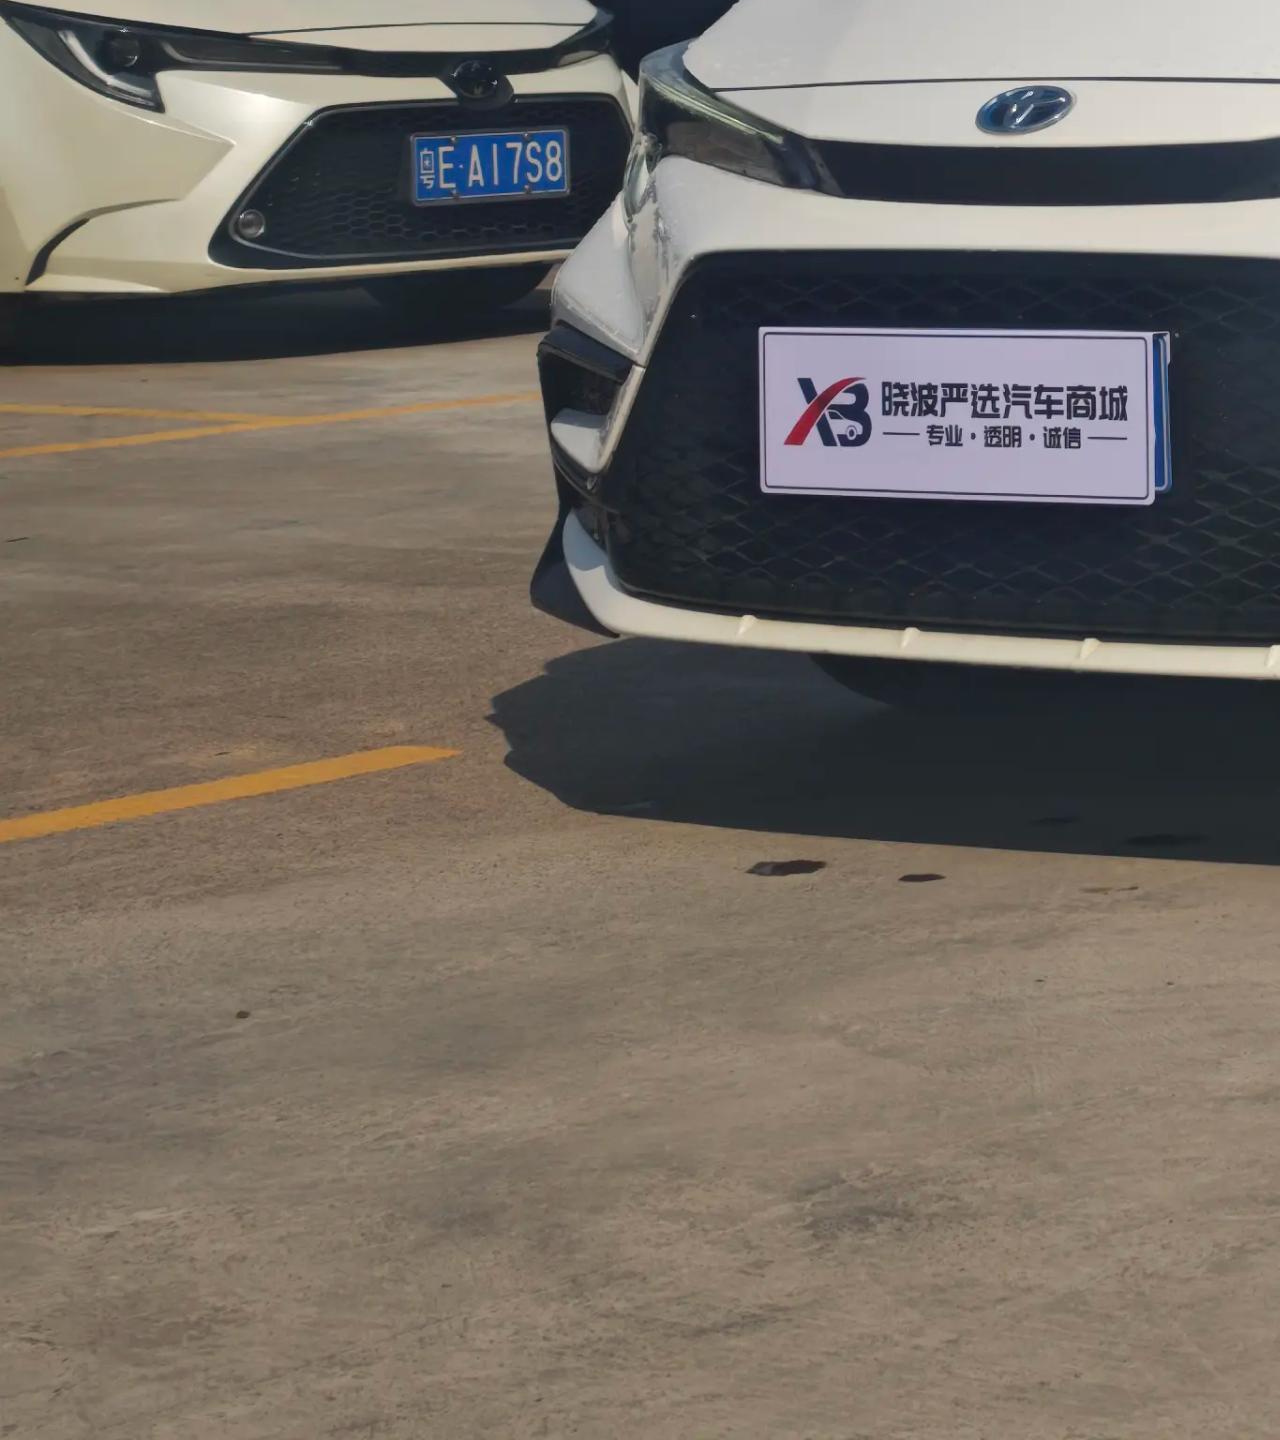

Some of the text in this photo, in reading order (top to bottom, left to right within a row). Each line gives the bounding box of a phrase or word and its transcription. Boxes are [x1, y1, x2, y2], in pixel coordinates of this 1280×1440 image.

[881, 381, 1129, 422] 晓波严选汽车商城
